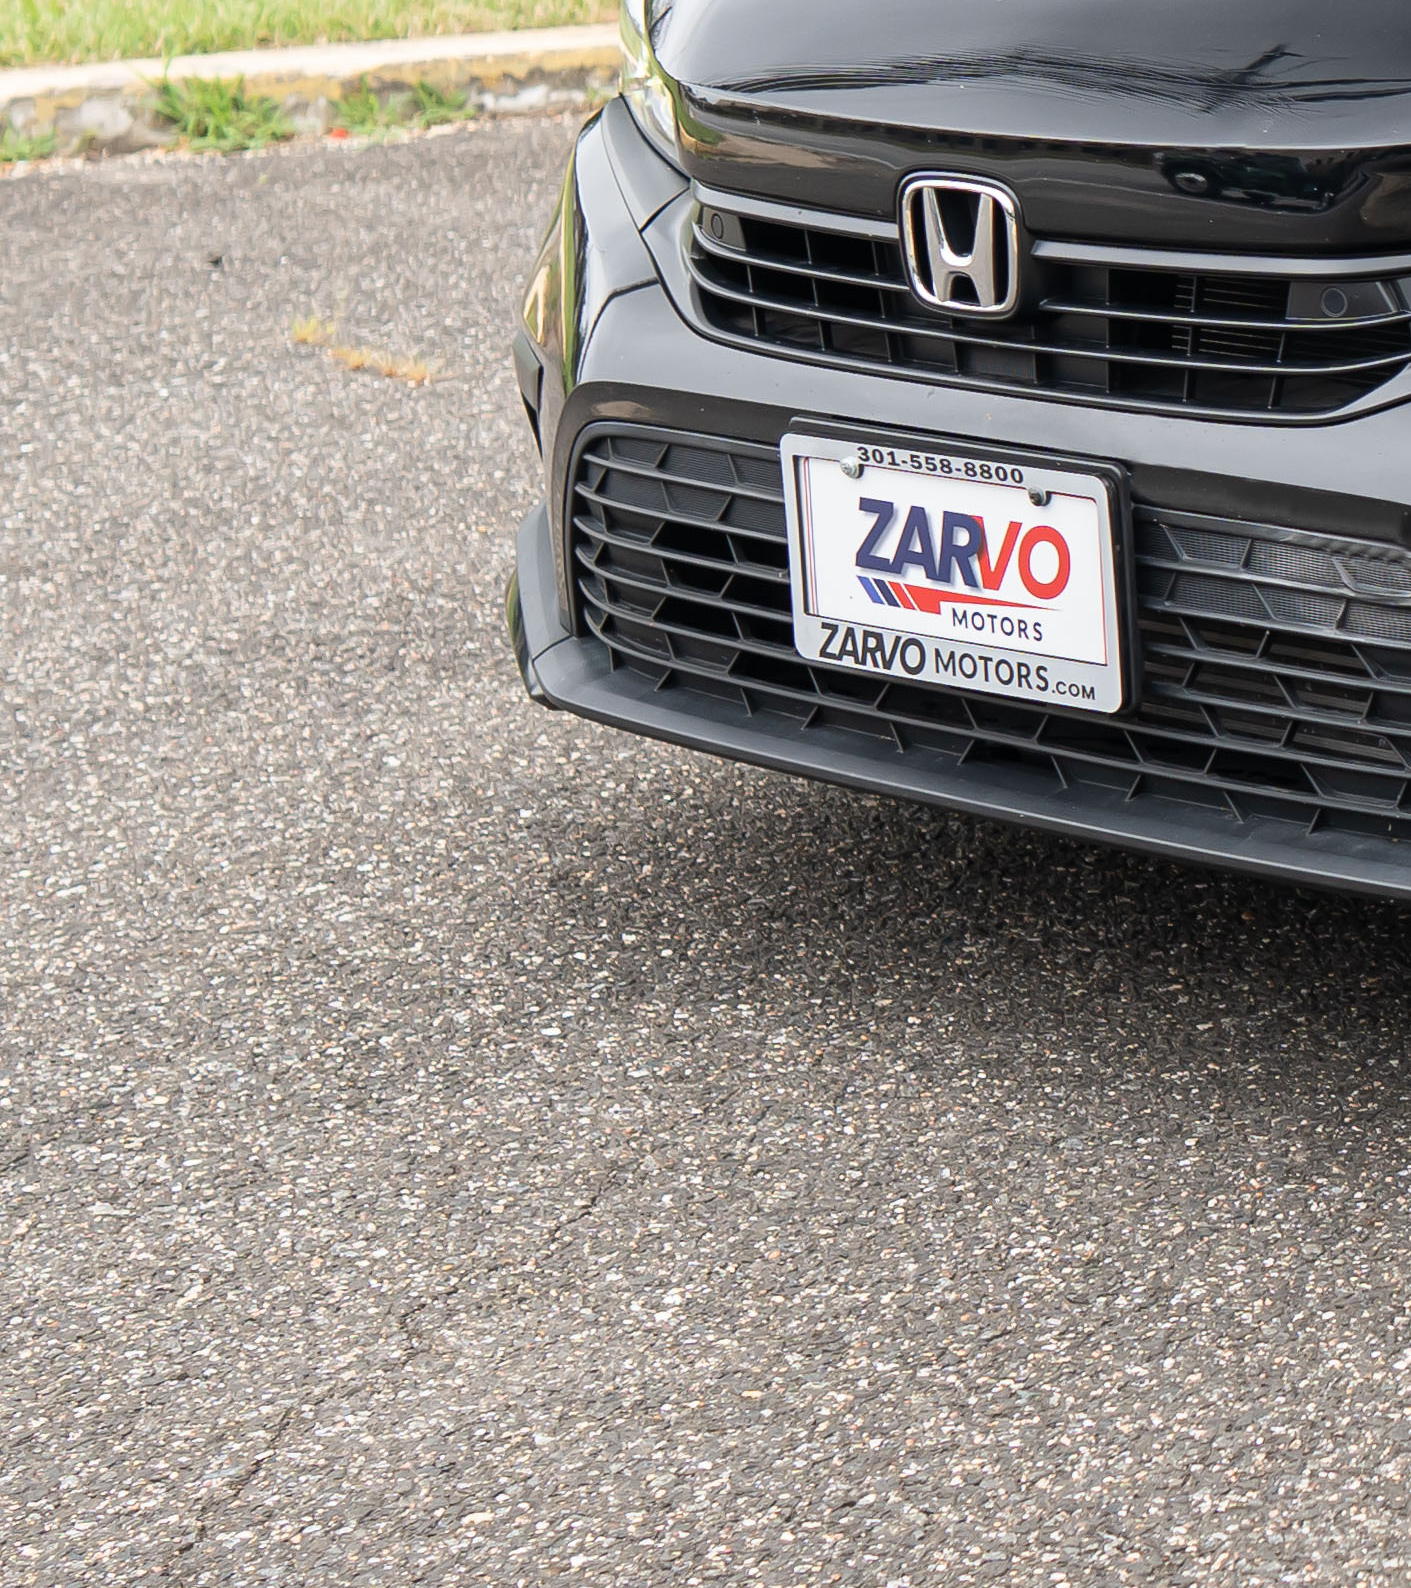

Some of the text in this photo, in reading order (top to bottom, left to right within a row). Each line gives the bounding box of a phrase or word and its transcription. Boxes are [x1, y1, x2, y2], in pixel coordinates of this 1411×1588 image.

[856, 446, 1024, 484] 301-558-8800
[855, 496, 1071, 600] ZARVO
[952, 607, 1043, 642] MOTORS
[819, 622, 926, 675] ZARVO
